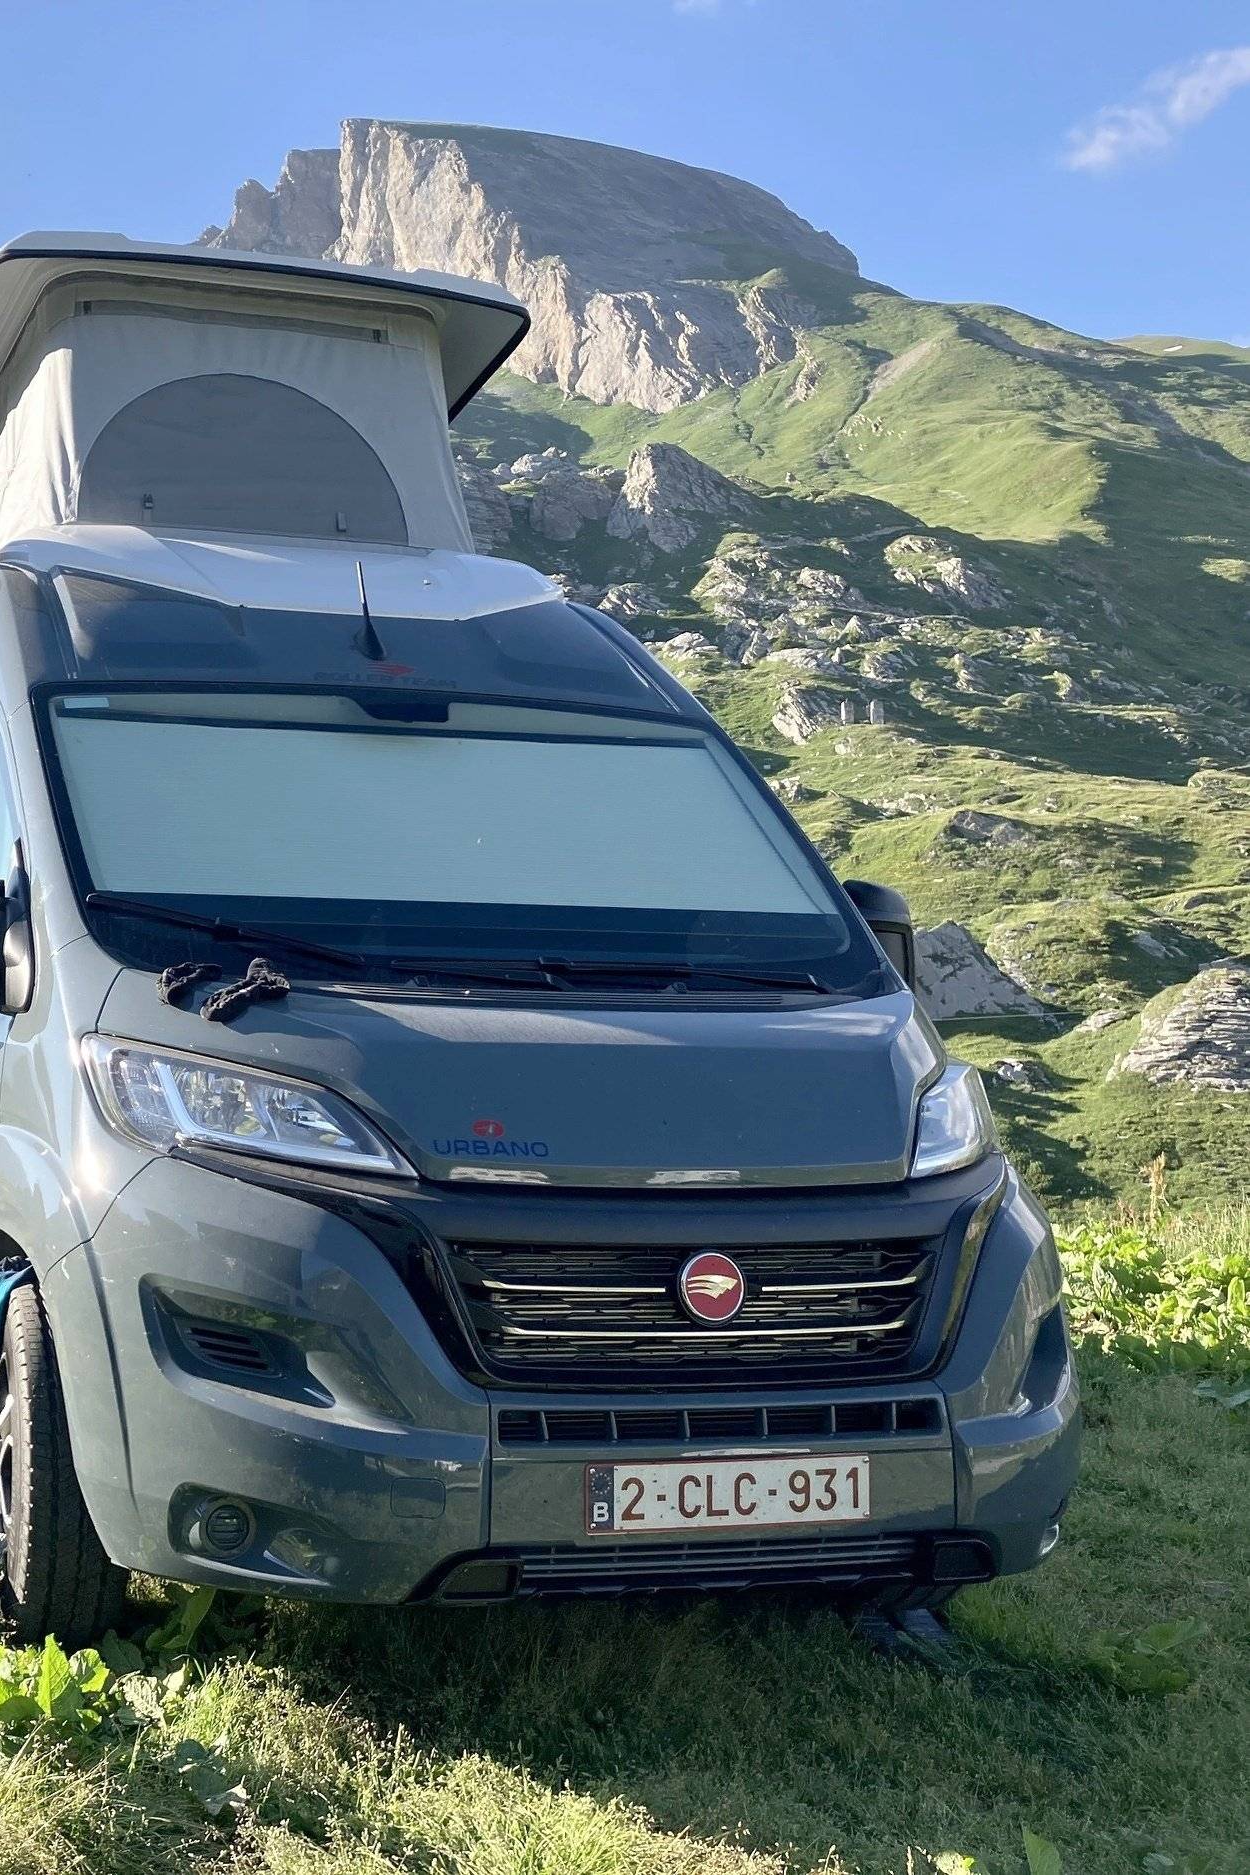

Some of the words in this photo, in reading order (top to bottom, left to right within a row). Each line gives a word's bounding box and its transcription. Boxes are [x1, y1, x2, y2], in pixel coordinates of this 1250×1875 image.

[432, 1139, 550, 1158] URBANO
[620, 1466, 860, 1522] 2-CLC-931
[592, 1501, 610, 1523] B
